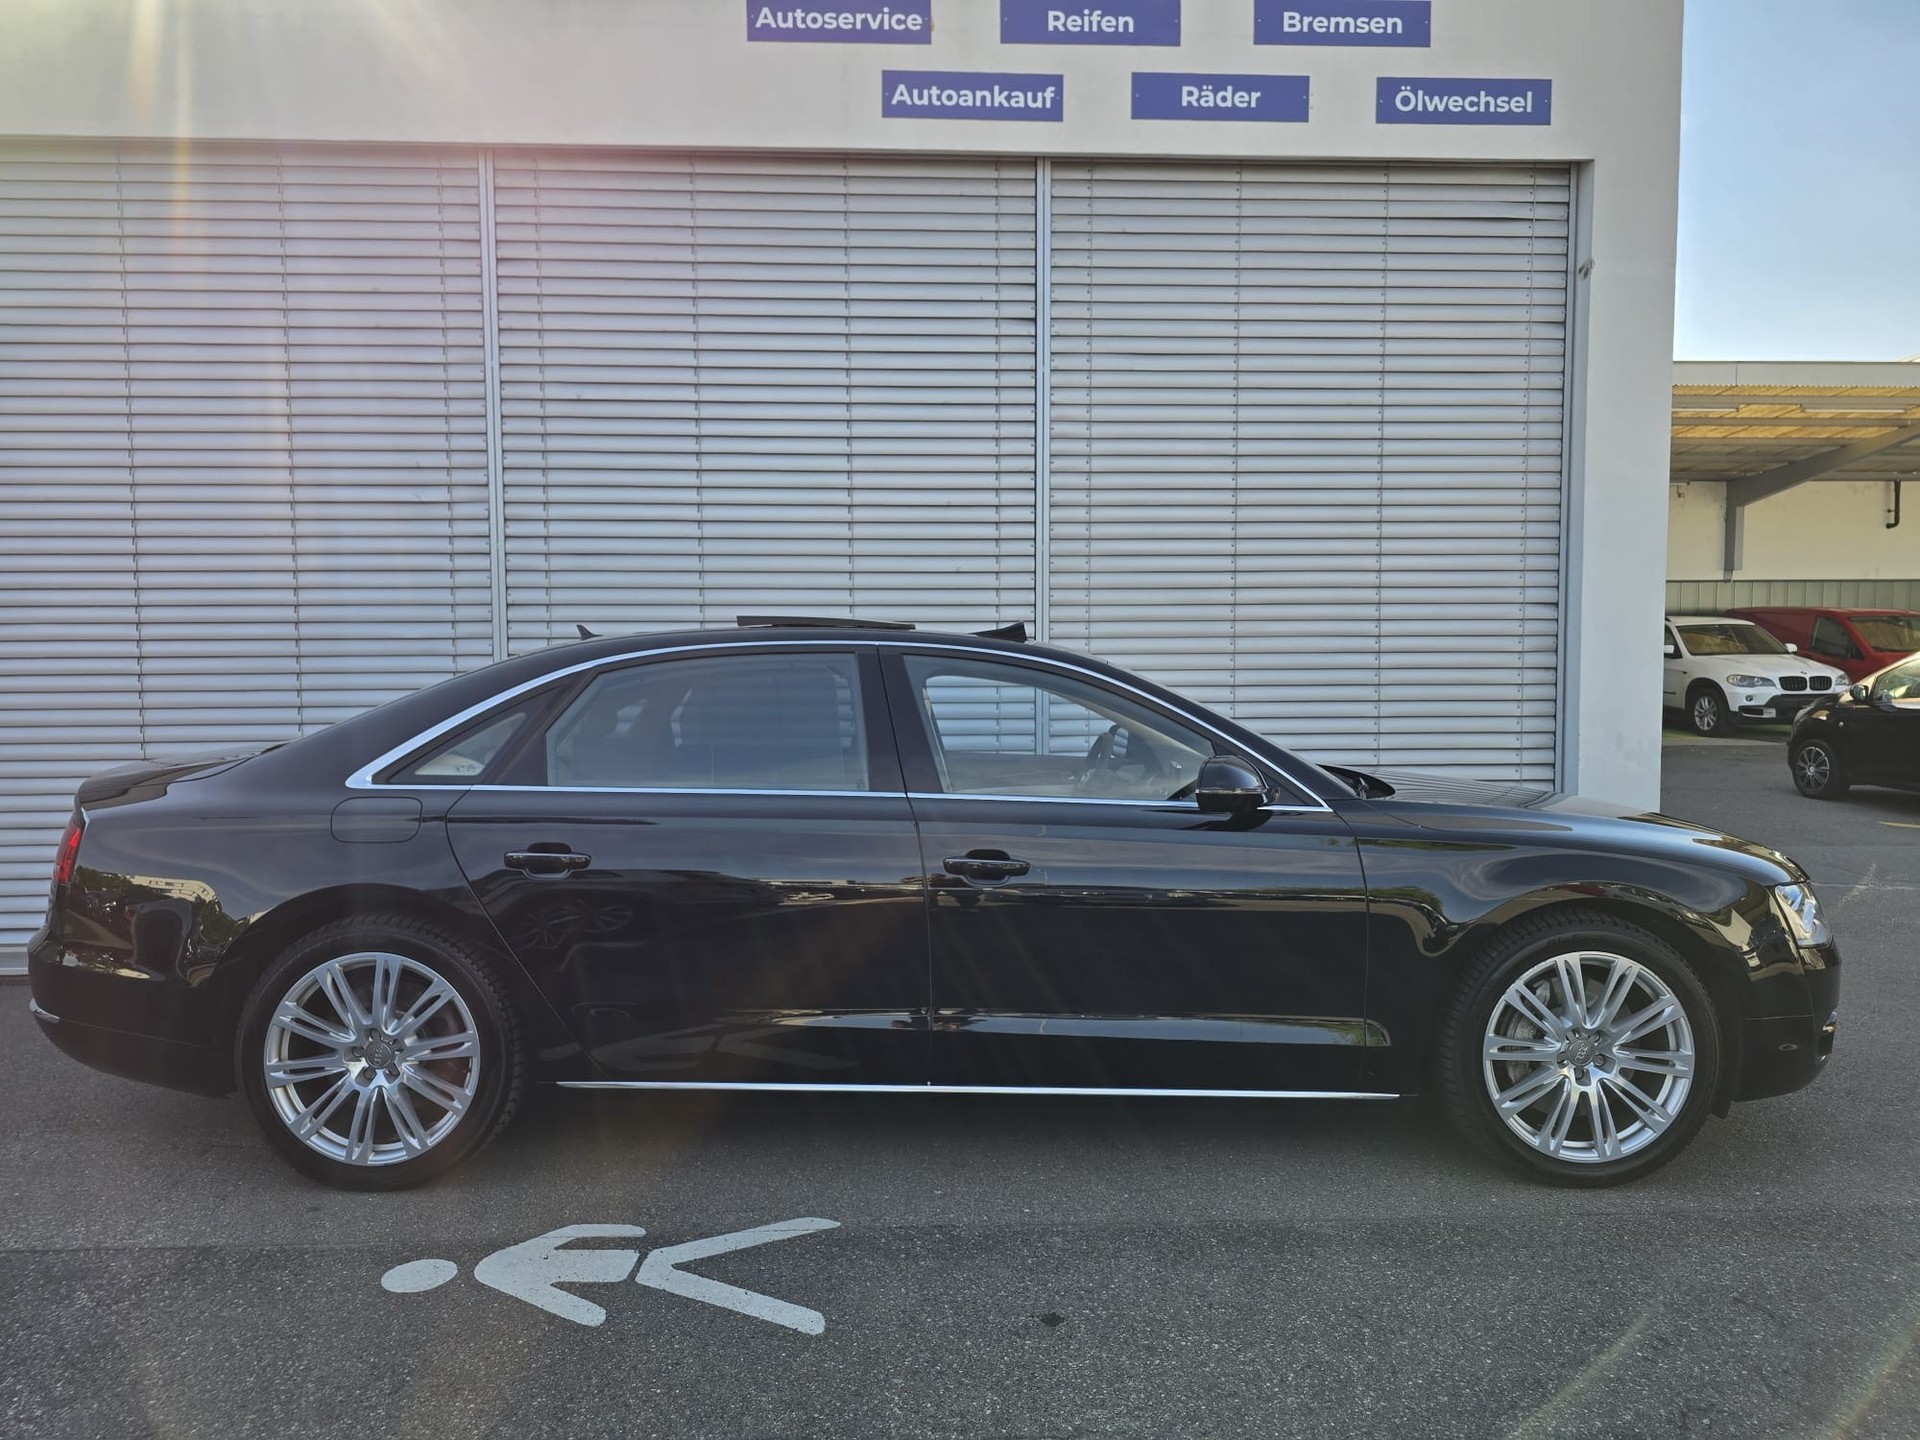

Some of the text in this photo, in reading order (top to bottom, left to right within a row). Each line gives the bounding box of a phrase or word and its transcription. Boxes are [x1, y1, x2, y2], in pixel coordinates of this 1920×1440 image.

[755, 7, 923, 31] Autoservice
[1047, 9, 1134, 33] Reifen
[1283, 11, 1403, 34] Bremsen
[891, 84, 1056, 109] Autoankauf
[1181, 85, 1261, 108] Räder
[1395, 85, 1533, 113] Ölwechsel
